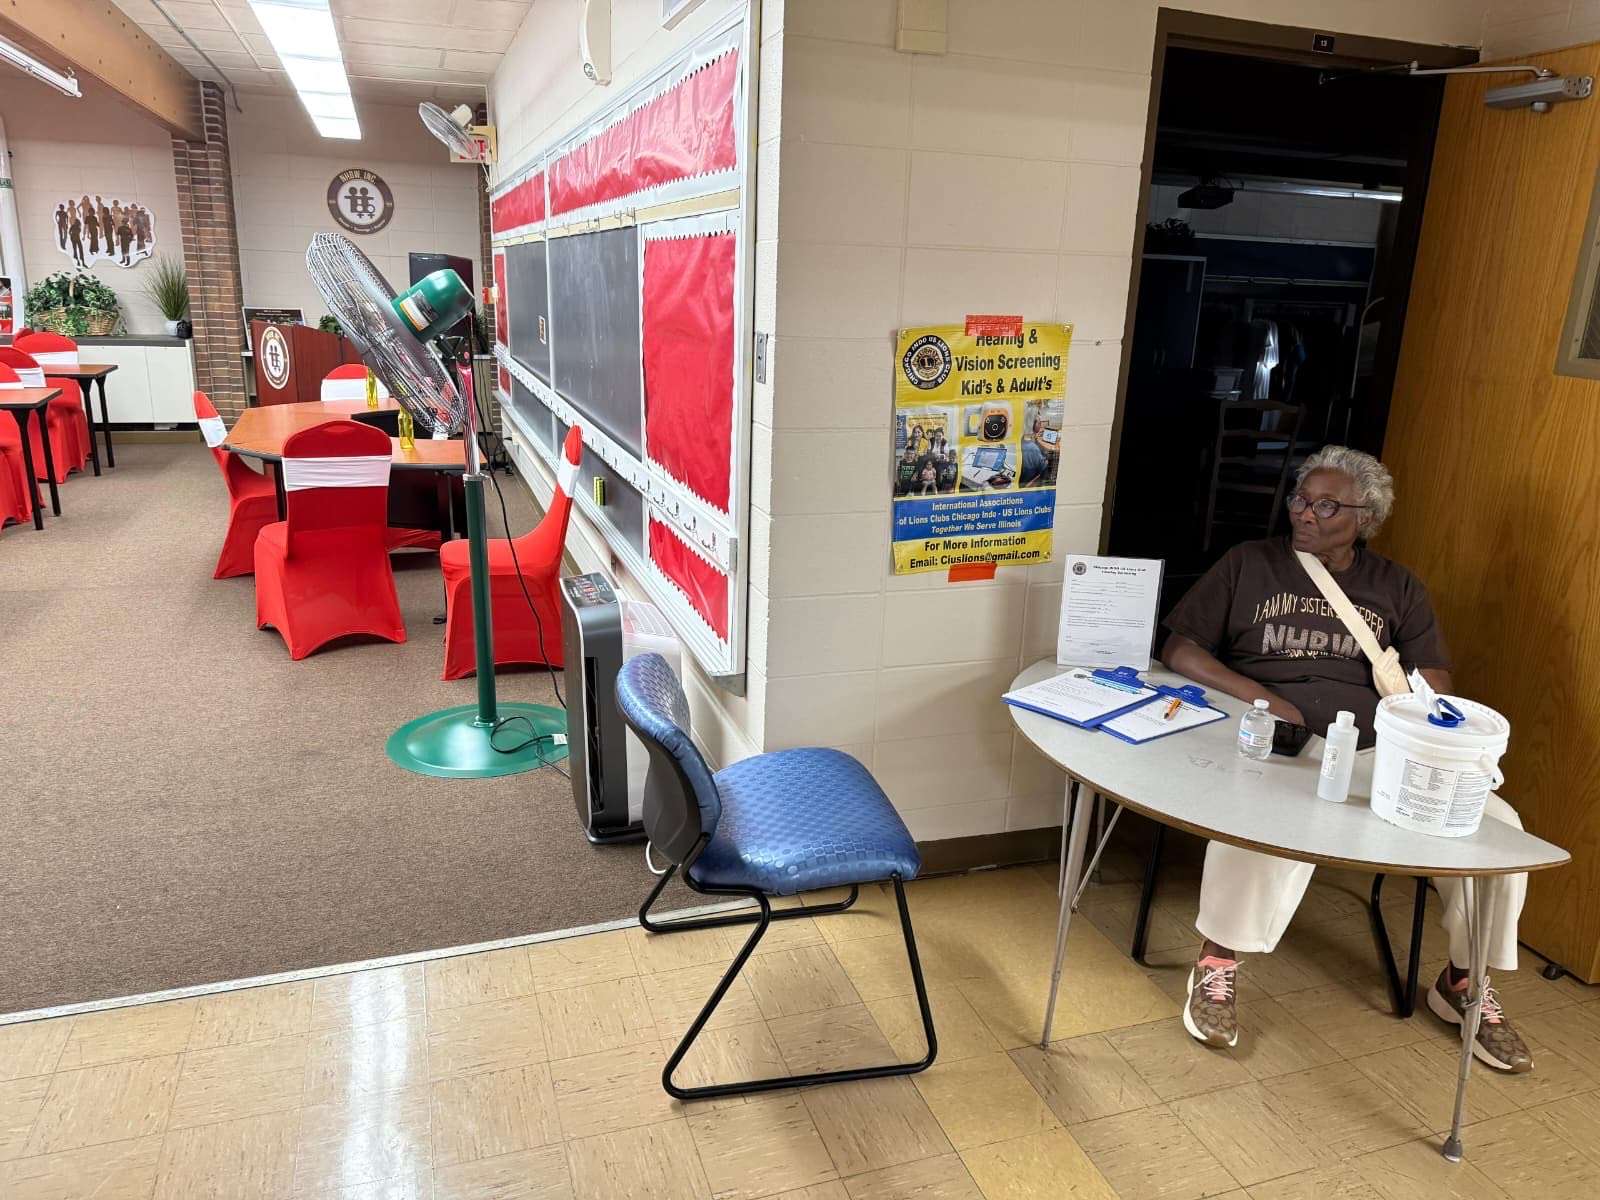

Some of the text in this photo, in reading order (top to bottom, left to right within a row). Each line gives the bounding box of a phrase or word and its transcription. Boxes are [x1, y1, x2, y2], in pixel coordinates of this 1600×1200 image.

[911, 336, 928, 351] INDO
[976, 329, 1038, 348] Hearing &
[937, 340, 951, 362] LIONS
[904, 351, 919, 385] CHICAGO
[955, 352, 1061, 371] Vision Screening
[937, 364, 951, 384] CLUB
[961, 376, 1053, 395] Kid's & Adult's
[932, 497, 1024, 511] International Associations
[899, 516, 907, 525] of
[909, 515, 928, 525] Lions
[930, 513, 950, 523] Clubs
[951, 511, 980, 522] Chicago
[982, 510, 997, 519] Indo
[1002, 508, 1012, 516] US
[1014, 506, 1033, 516] Lions
[1034, 505, 1052, 514] Clubs
[931, 520, 1022, 534] Together We Serve Illinois
[924, 535, 1026, 552] For More Information
[910, 556, 938, 569] Email:
[1252, 603, 1260, 624] I
[1259, 594, 1281, 621] AM
[1280, 592, 1298, 615] MY
